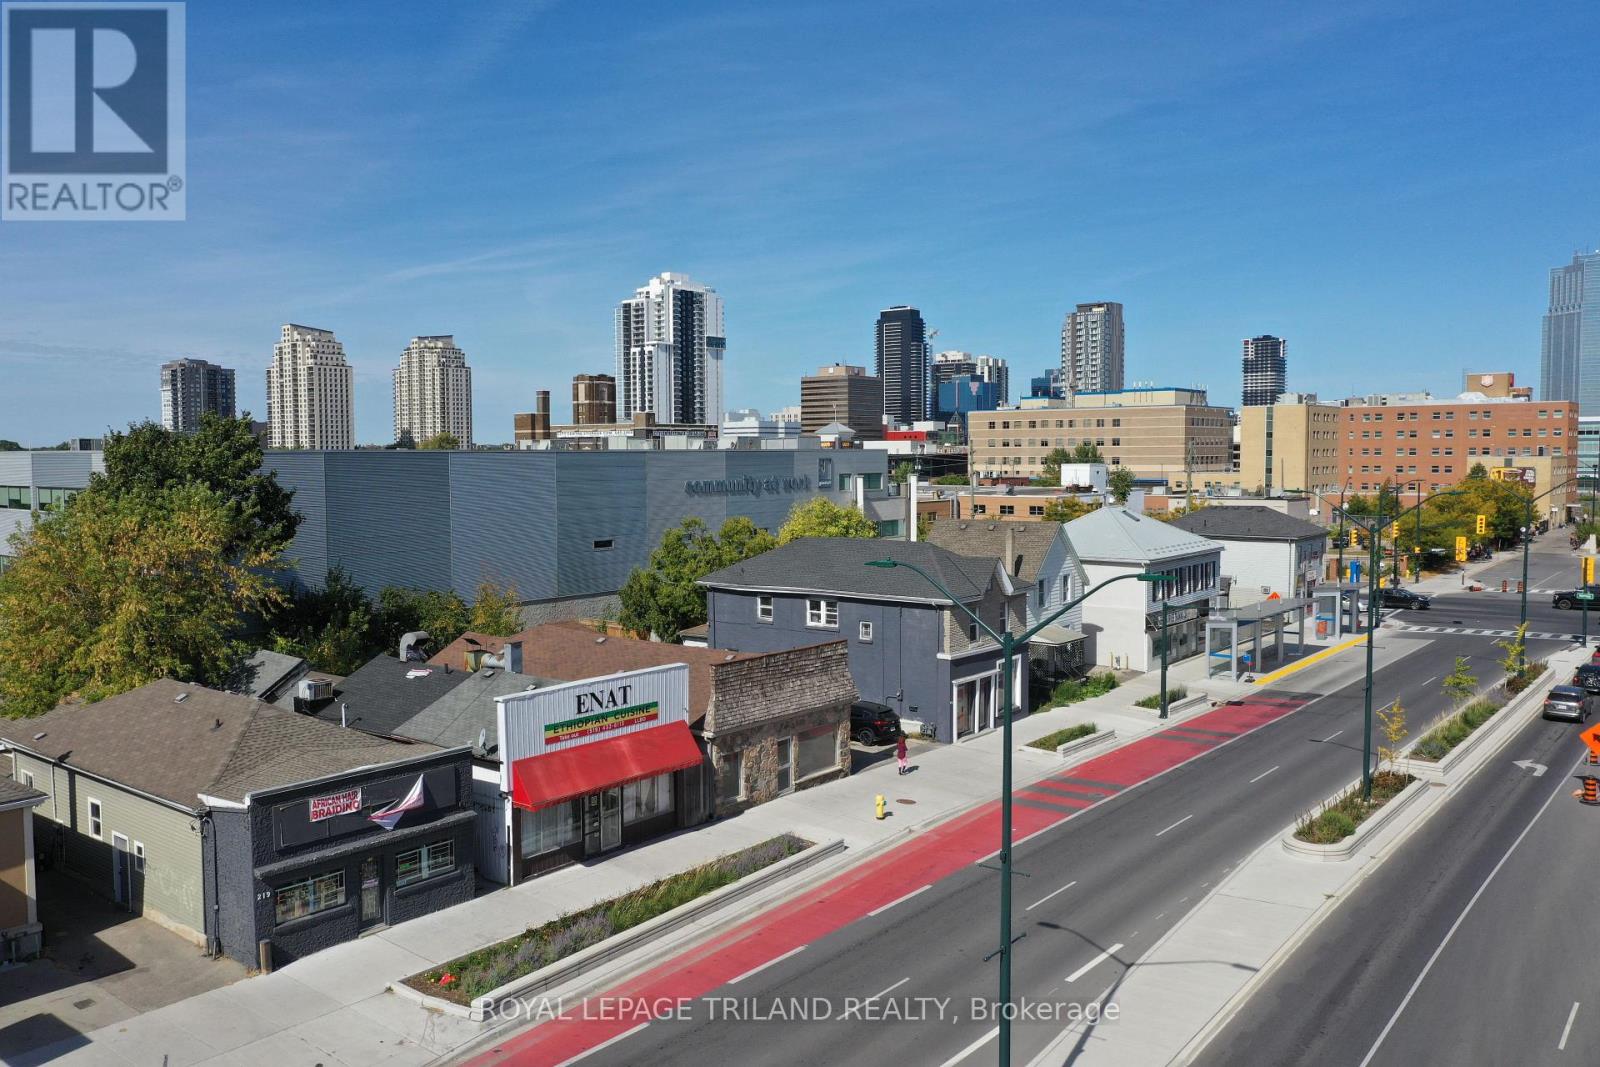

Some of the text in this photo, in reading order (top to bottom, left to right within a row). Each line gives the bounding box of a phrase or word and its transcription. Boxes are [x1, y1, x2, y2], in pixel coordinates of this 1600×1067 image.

[576, 685, 631, 714] ENAT
[553, 706, 651, 734] ETHIOPIAN CUISINE
[312, 790, 359, 810] AFRICAN HAIR
[312, 800, 360, 820] BRAIDING
[257, 891, 271, 900] 219
